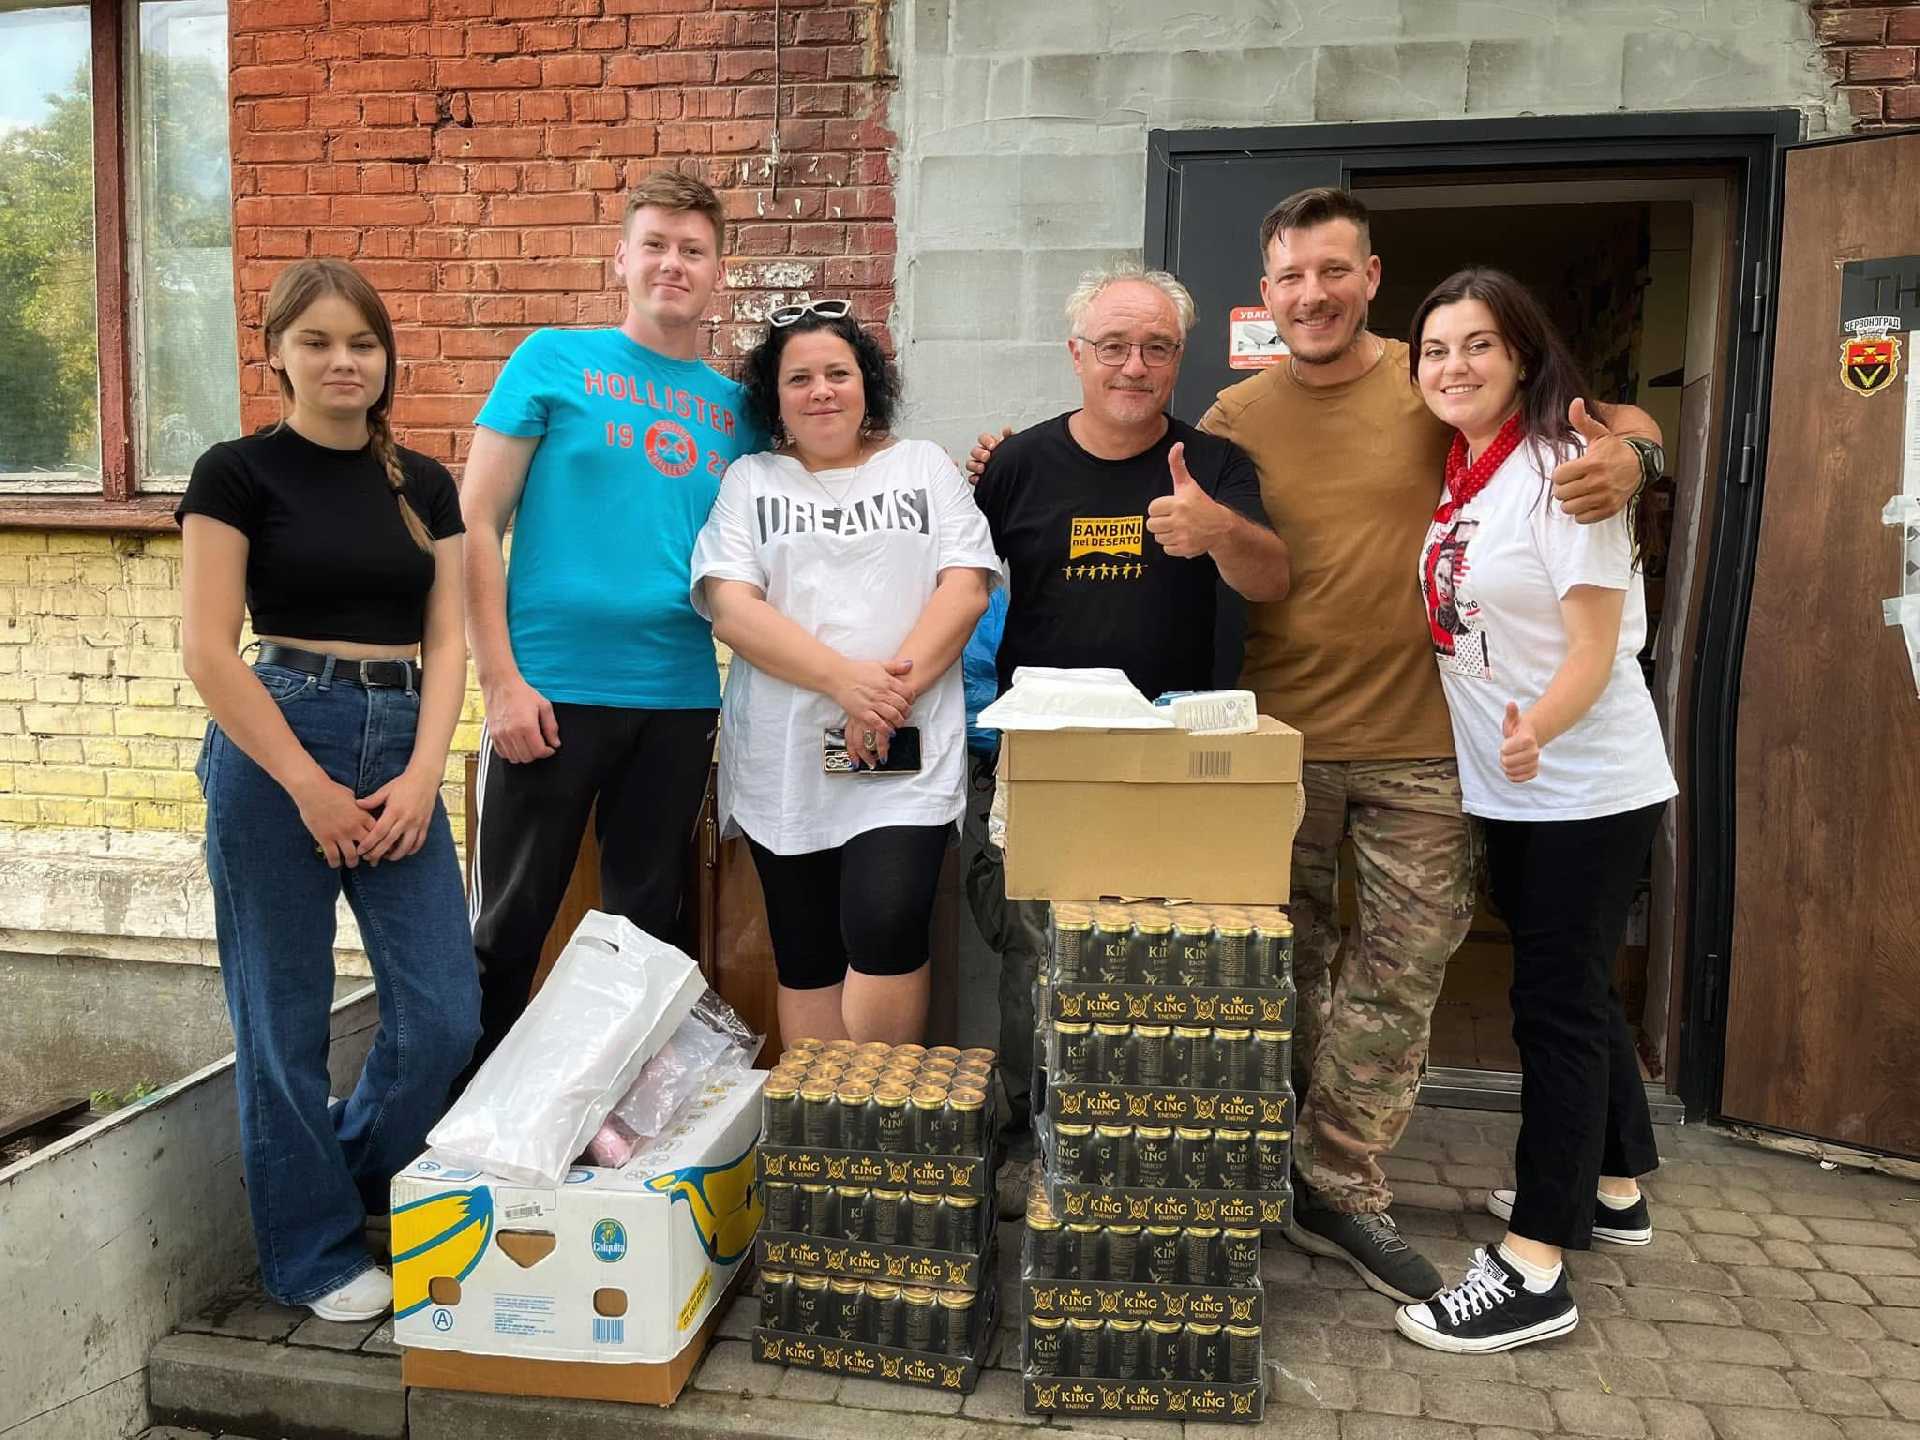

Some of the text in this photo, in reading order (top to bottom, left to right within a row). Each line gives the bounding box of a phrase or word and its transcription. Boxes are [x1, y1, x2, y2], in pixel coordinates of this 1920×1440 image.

[1240, 311, 1270, 320] УВАГ
[584, 367, 736, 440] HOLLISTER
[605, 420, 634, 449] 19
[756, 487, 930, 545] DREAMS
[1073, 523, 1141, 538] BAMBINI
[1073, 535, 1141, 547] nel DESERTO
[1105, 944, 1128, 957] KIN
[1184, 947, 1207, 960] KIN
[1087, 1000, 1120, 1011] KING
[1154, 1001, 1187, 1013] KING
[1220, 1004, 1255, 1015] KING
[1067, 1046, 1088, 1057] KIN
[1087, 1098, 1121, 1110] KING
[1154, 1100, 1187, 1112] KING
[1220, 1103, 1255, 1115] KING
[879, 1117, 904, 1129] KIN
[1057, 1145, 1080, 1158] ING
[1226, 1152, 1248, 1163] KIN
[789, 1161, 820, 1172] KING
[851, 1164, 882, 1176] KING
[913, 1168, 945, 1180] KING
[1090, 1200, 1122, 1213] KING
[1154, 1202, 1188, 1215] KING
[1220, 1204, 1254, 1216] KING
[790, 1247, 820, 1261] KING
[1153, 1246, 1177, 1259] KIN
[849, 1256, 880, 1269] KING
[910, 1262, 942, 1276] KING
[1059, 1294, 1092, 1306] KING
[1124, 1297, 1157, 1309] KING
[1190, 1301, 1224, 1313] KING
[1034, 1338, 1061, 1351] KIN
[785, 1346, 816, 1360] KING
[844, 1354, 875, 1369] KING
[904, 1364, 935, 1379] KING
[1062, 1391, 1095, 1403] KING
[1126, 1393, 1159, 1405] KING
[1192, 1396, 1225, 1408] KING
